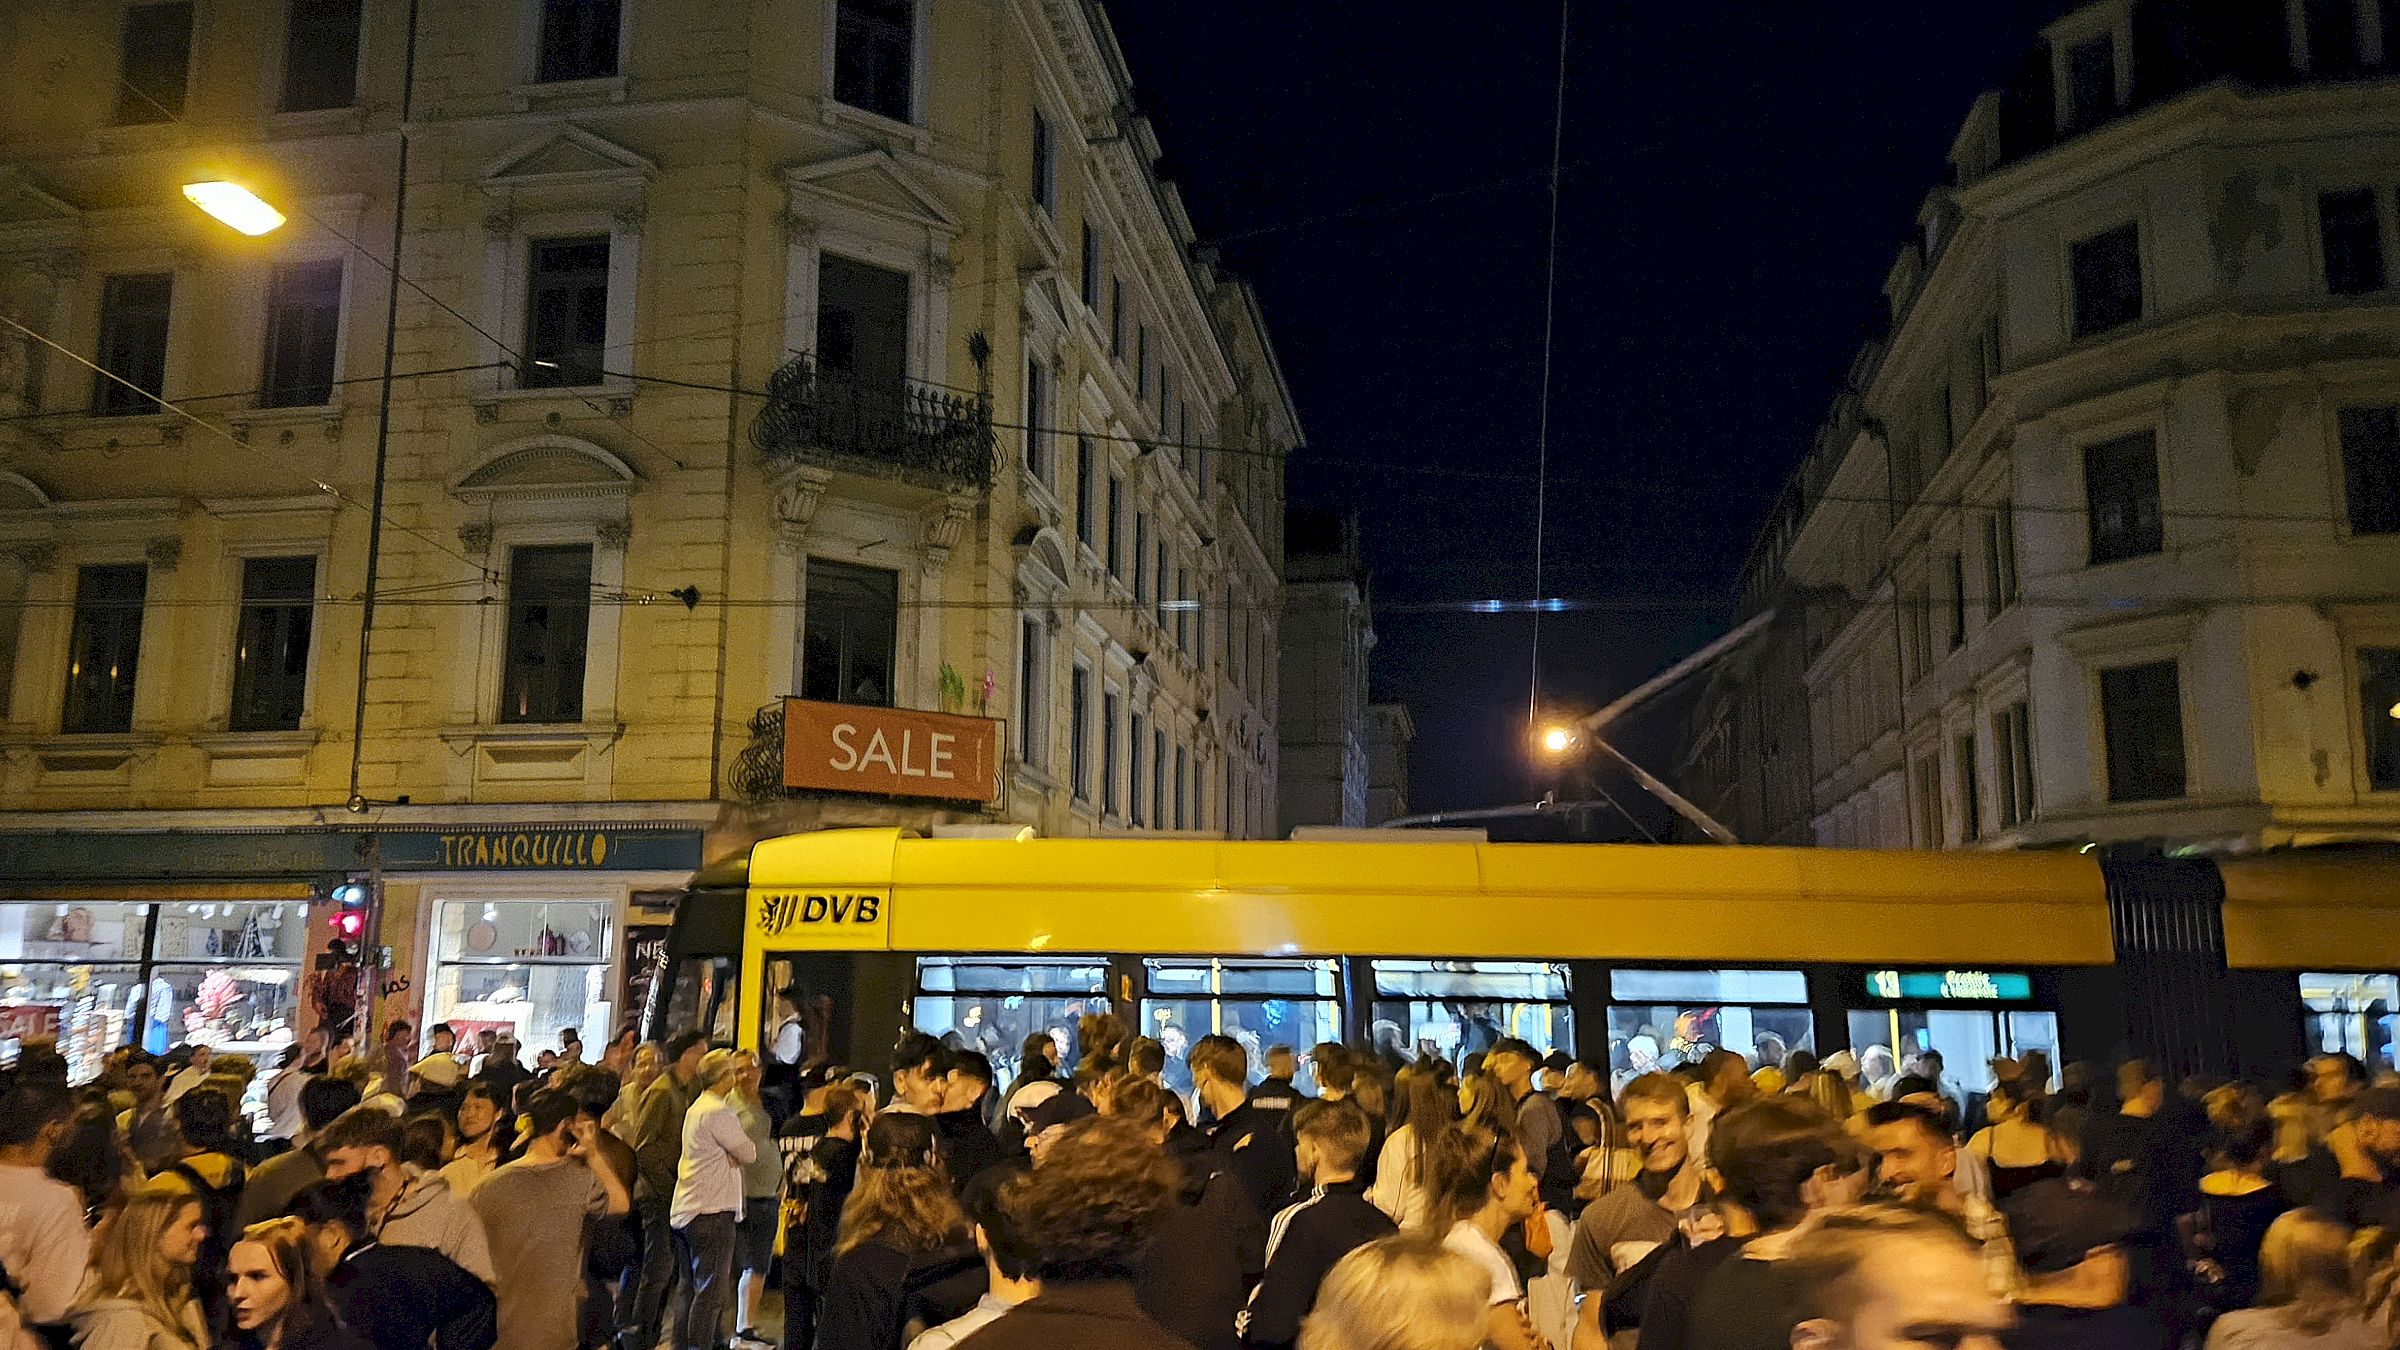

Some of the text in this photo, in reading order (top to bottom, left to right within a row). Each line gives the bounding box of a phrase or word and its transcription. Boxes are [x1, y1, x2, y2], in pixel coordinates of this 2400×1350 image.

[829, 723, 956, 779] SALE
[440, 833, 607, 867] TRANQUILLO
[801, 895, 880, 923] DVB
